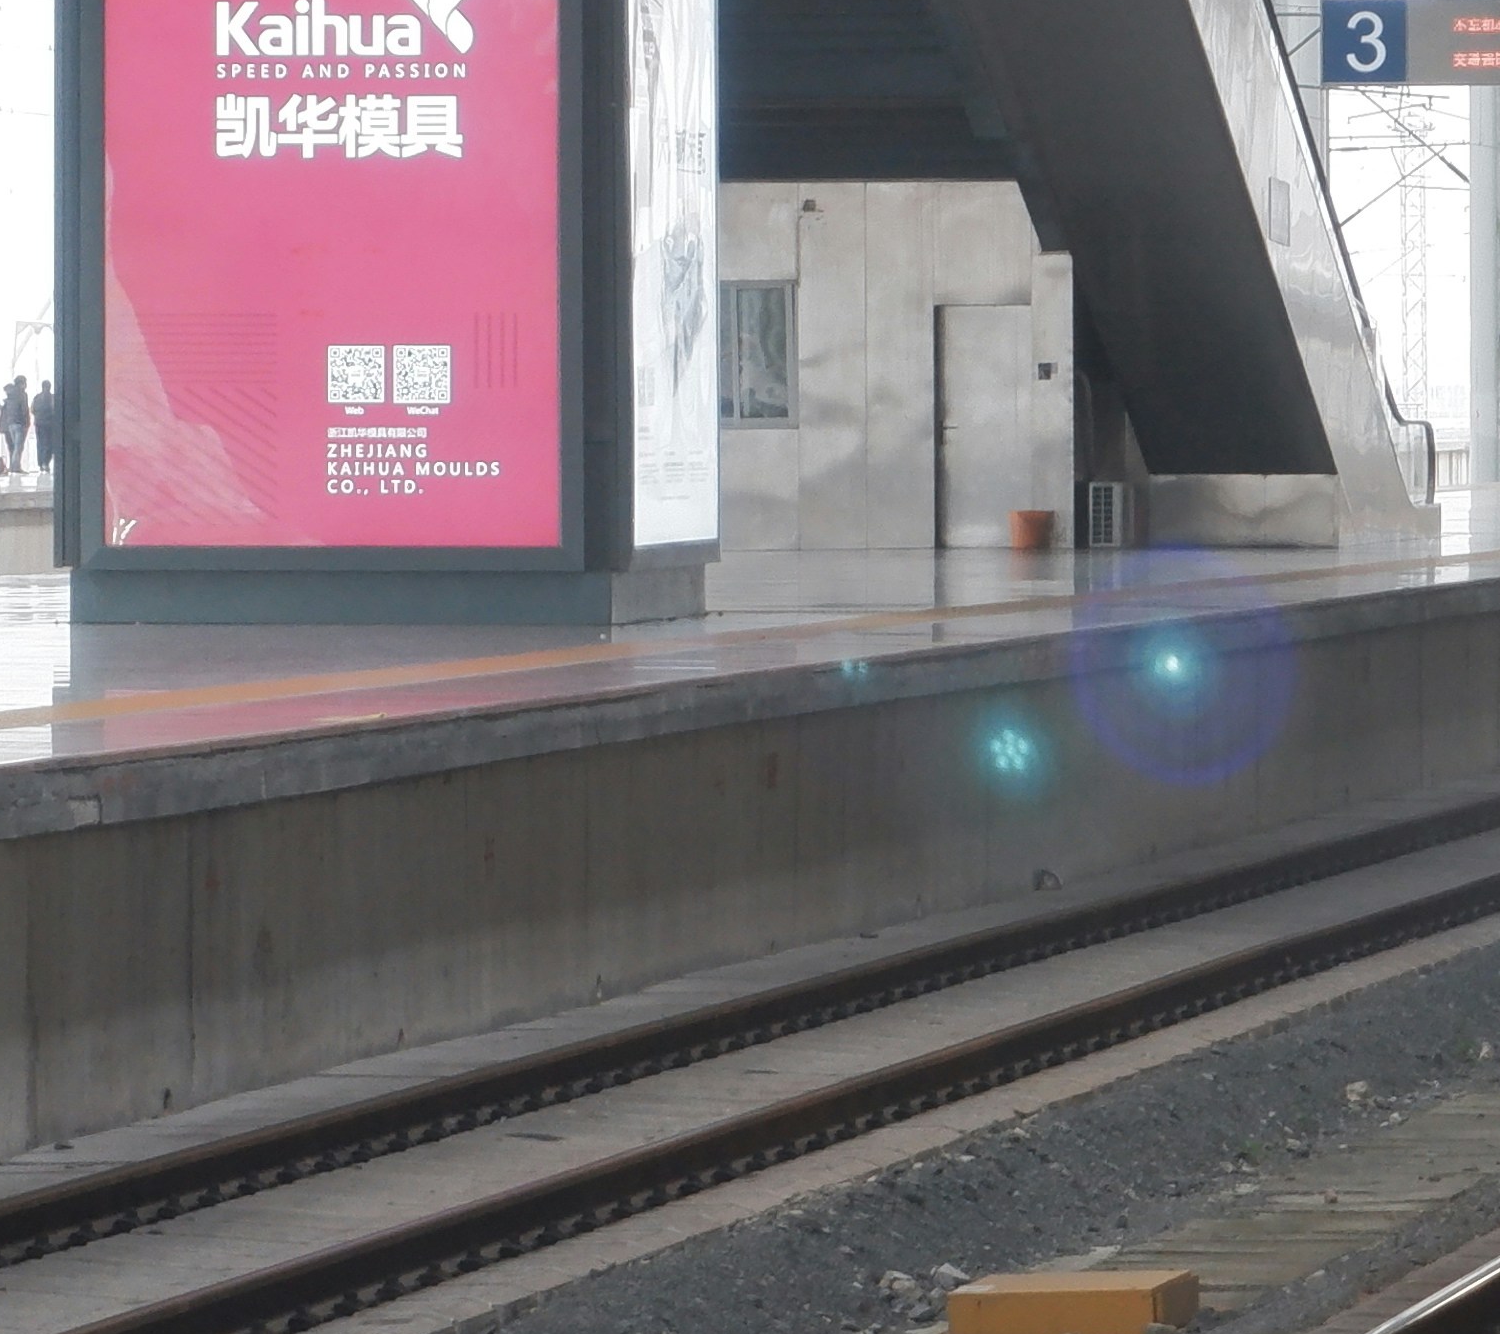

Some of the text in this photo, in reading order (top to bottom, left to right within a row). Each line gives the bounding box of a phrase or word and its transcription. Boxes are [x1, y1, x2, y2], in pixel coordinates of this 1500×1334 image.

[1346, 10, 1387, 73] 3
[216, 63, 466, 79] SPEED AND PASSION
[215, 93, 464, 159] 凯华模具
[344, 405, 439, 415] Web WeChat
[326, 443, 427, 459] ZHEJIANG
[327, 461, 500, 476] KAIHUA MOULDS
[326, 479, 424, 496] CO., LTD.
